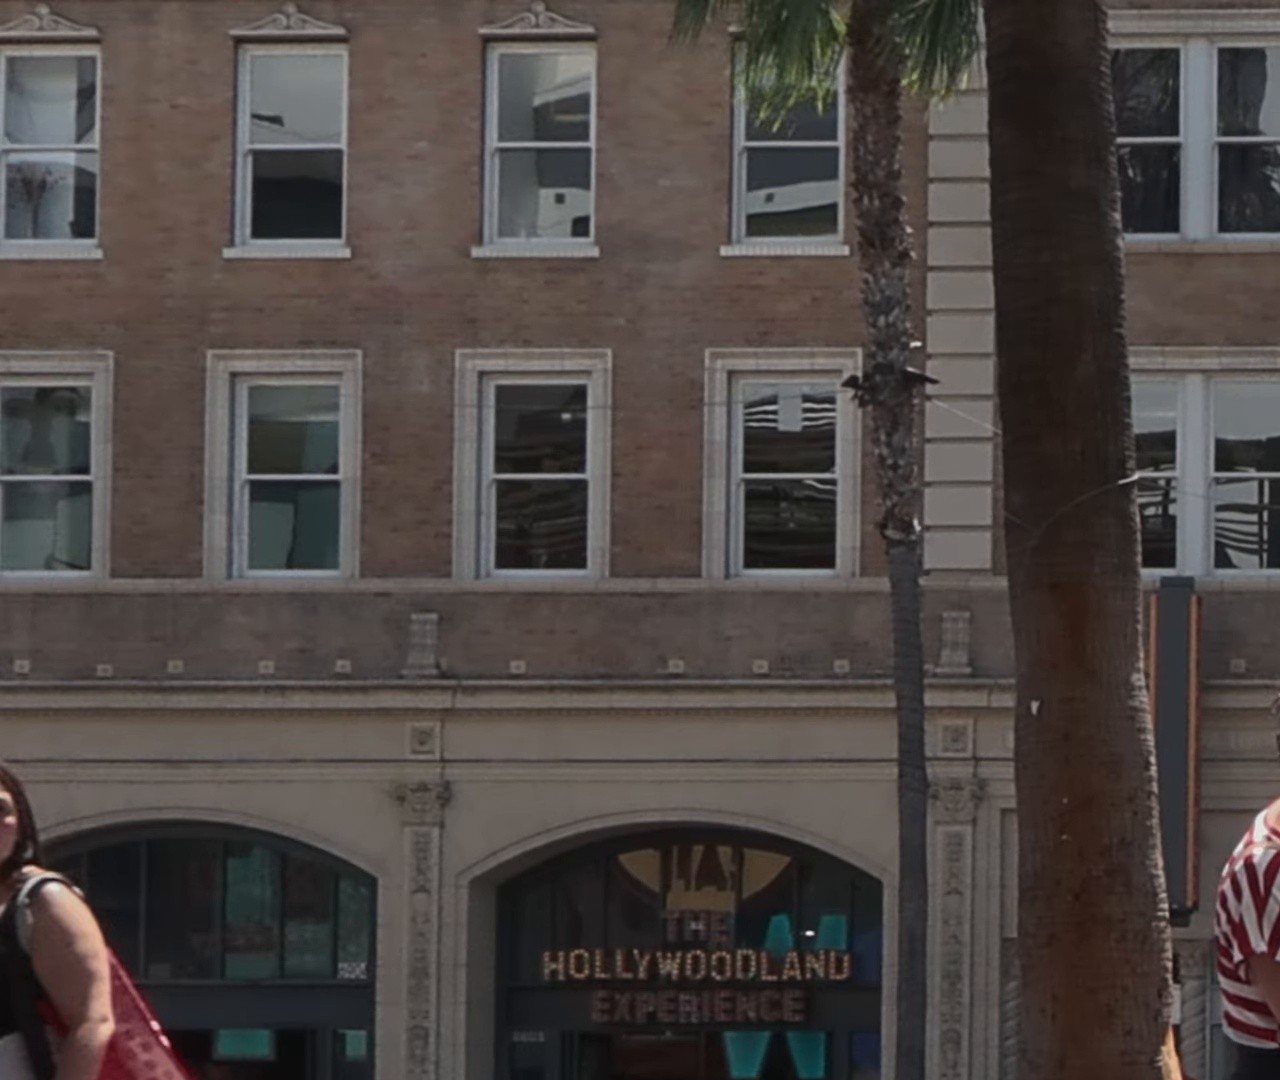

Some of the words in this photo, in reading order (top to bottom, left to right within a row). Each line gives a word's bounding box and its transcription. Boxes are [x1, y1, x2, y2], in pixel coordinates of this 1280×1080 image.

[666, 909, 728, 943] THE
[543, 949, 851, 982] HOLLYWOODLAND
[590, 989, 806, 1023] EXPERIENCE
